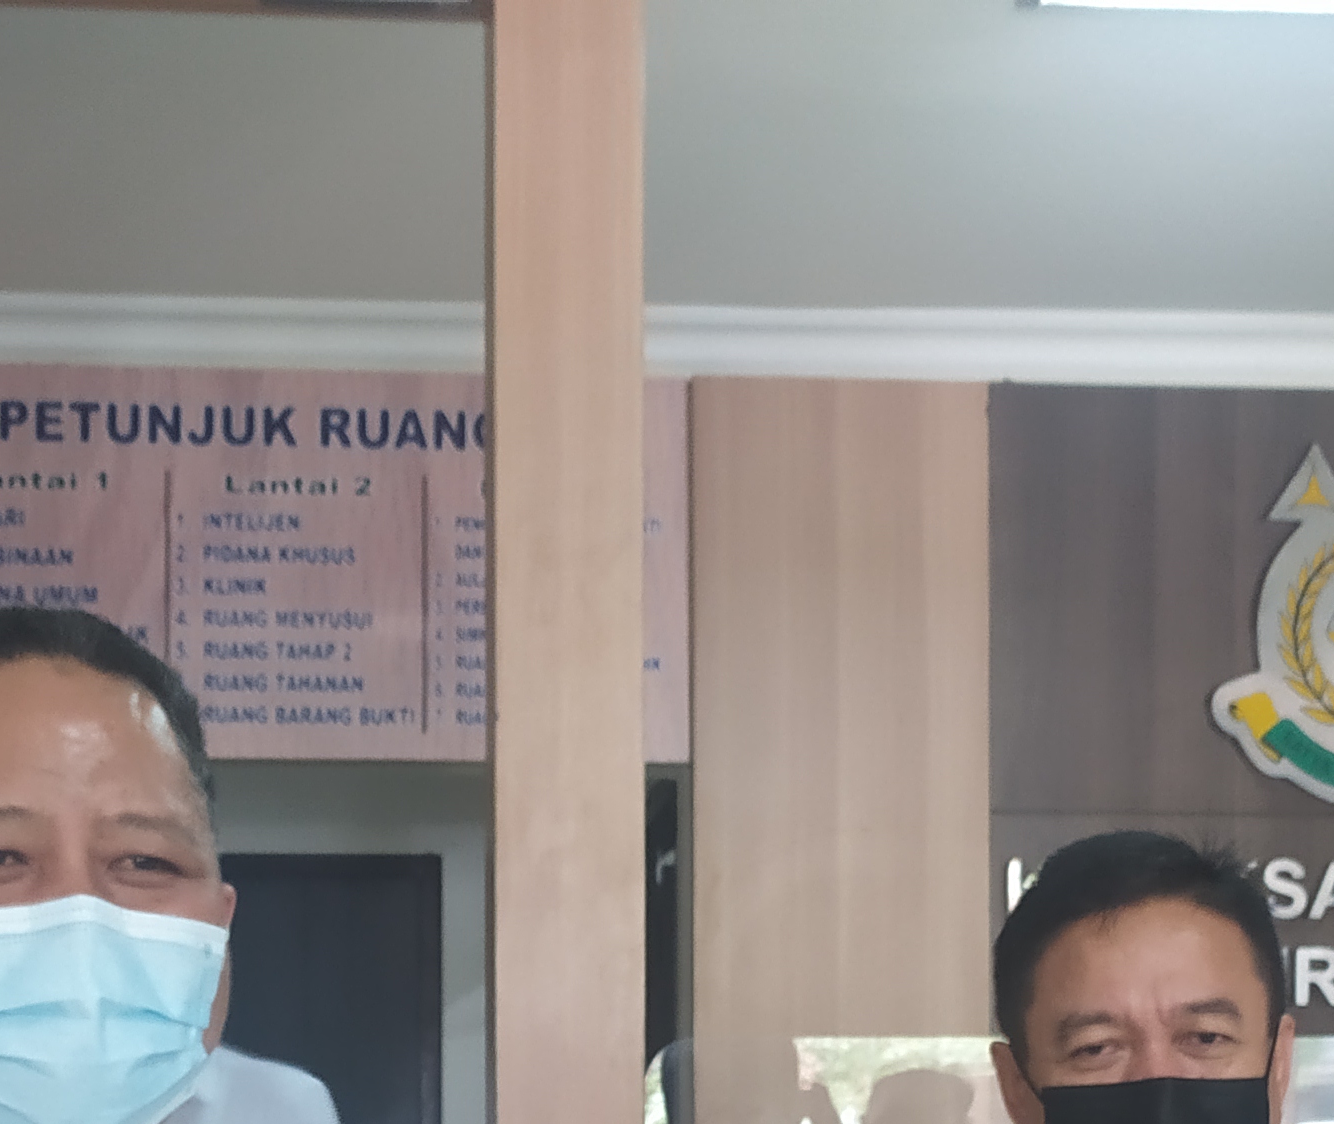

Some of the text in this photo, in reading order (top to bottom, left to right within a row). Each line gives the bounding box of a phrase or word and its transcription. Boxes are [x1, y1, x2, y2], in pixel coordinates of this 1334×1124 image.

[97, 471, 109, 491] 1
[225, 474, 371, 496] Lantai 2
[202, 544, 272, 564] PIDANA
[278, 544, 356, 566] KHUSUS
[33, 585, 99, 608] UMUM
[202, 576, 266, 596] KLINIK
[202, 609, 267, 628] RUANG
[275, 609, 373, 631] MENYUSUI
[203, 641, 268, 660] RUANG
[276, 641, 336, 660] TAHAP
[203, 672, 364, 692] RUANG TAHANAN
[201, 705, 415, 727] RUANG BARANG BUKTI
